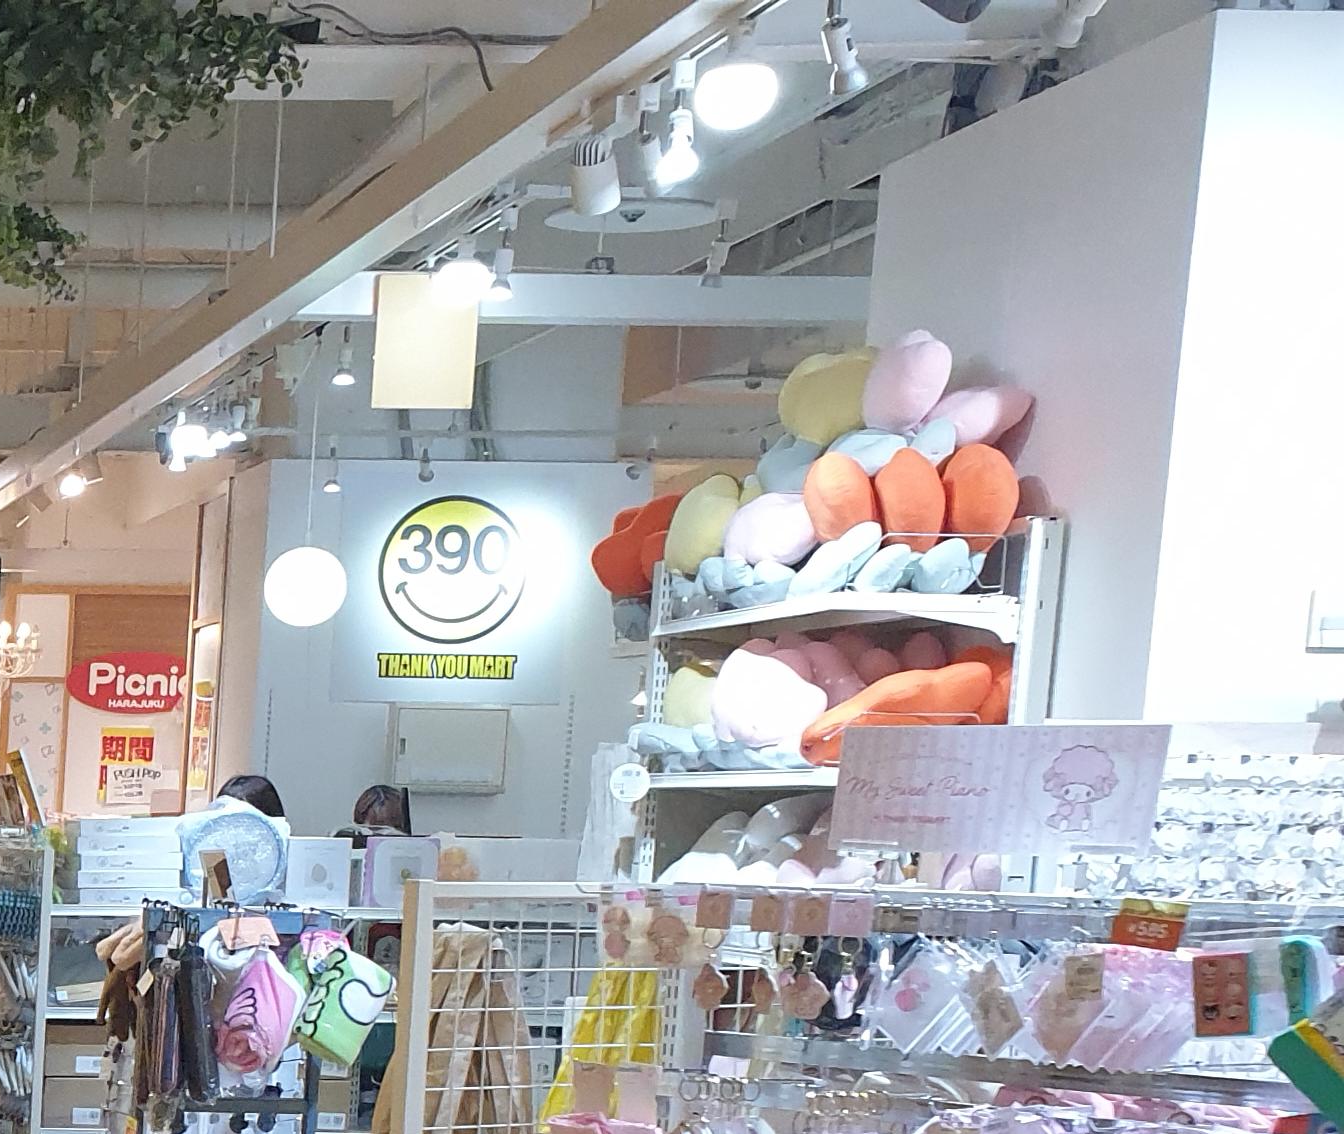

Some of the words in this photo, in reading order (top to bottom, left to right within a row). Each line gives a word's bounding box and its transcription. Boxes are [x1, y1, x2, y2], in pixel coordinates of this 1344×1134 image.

[398, 524, 509, 575] 390
[108, 699, 165, 708] HARAJUKU
[101, 736, 154, 761] 期間
